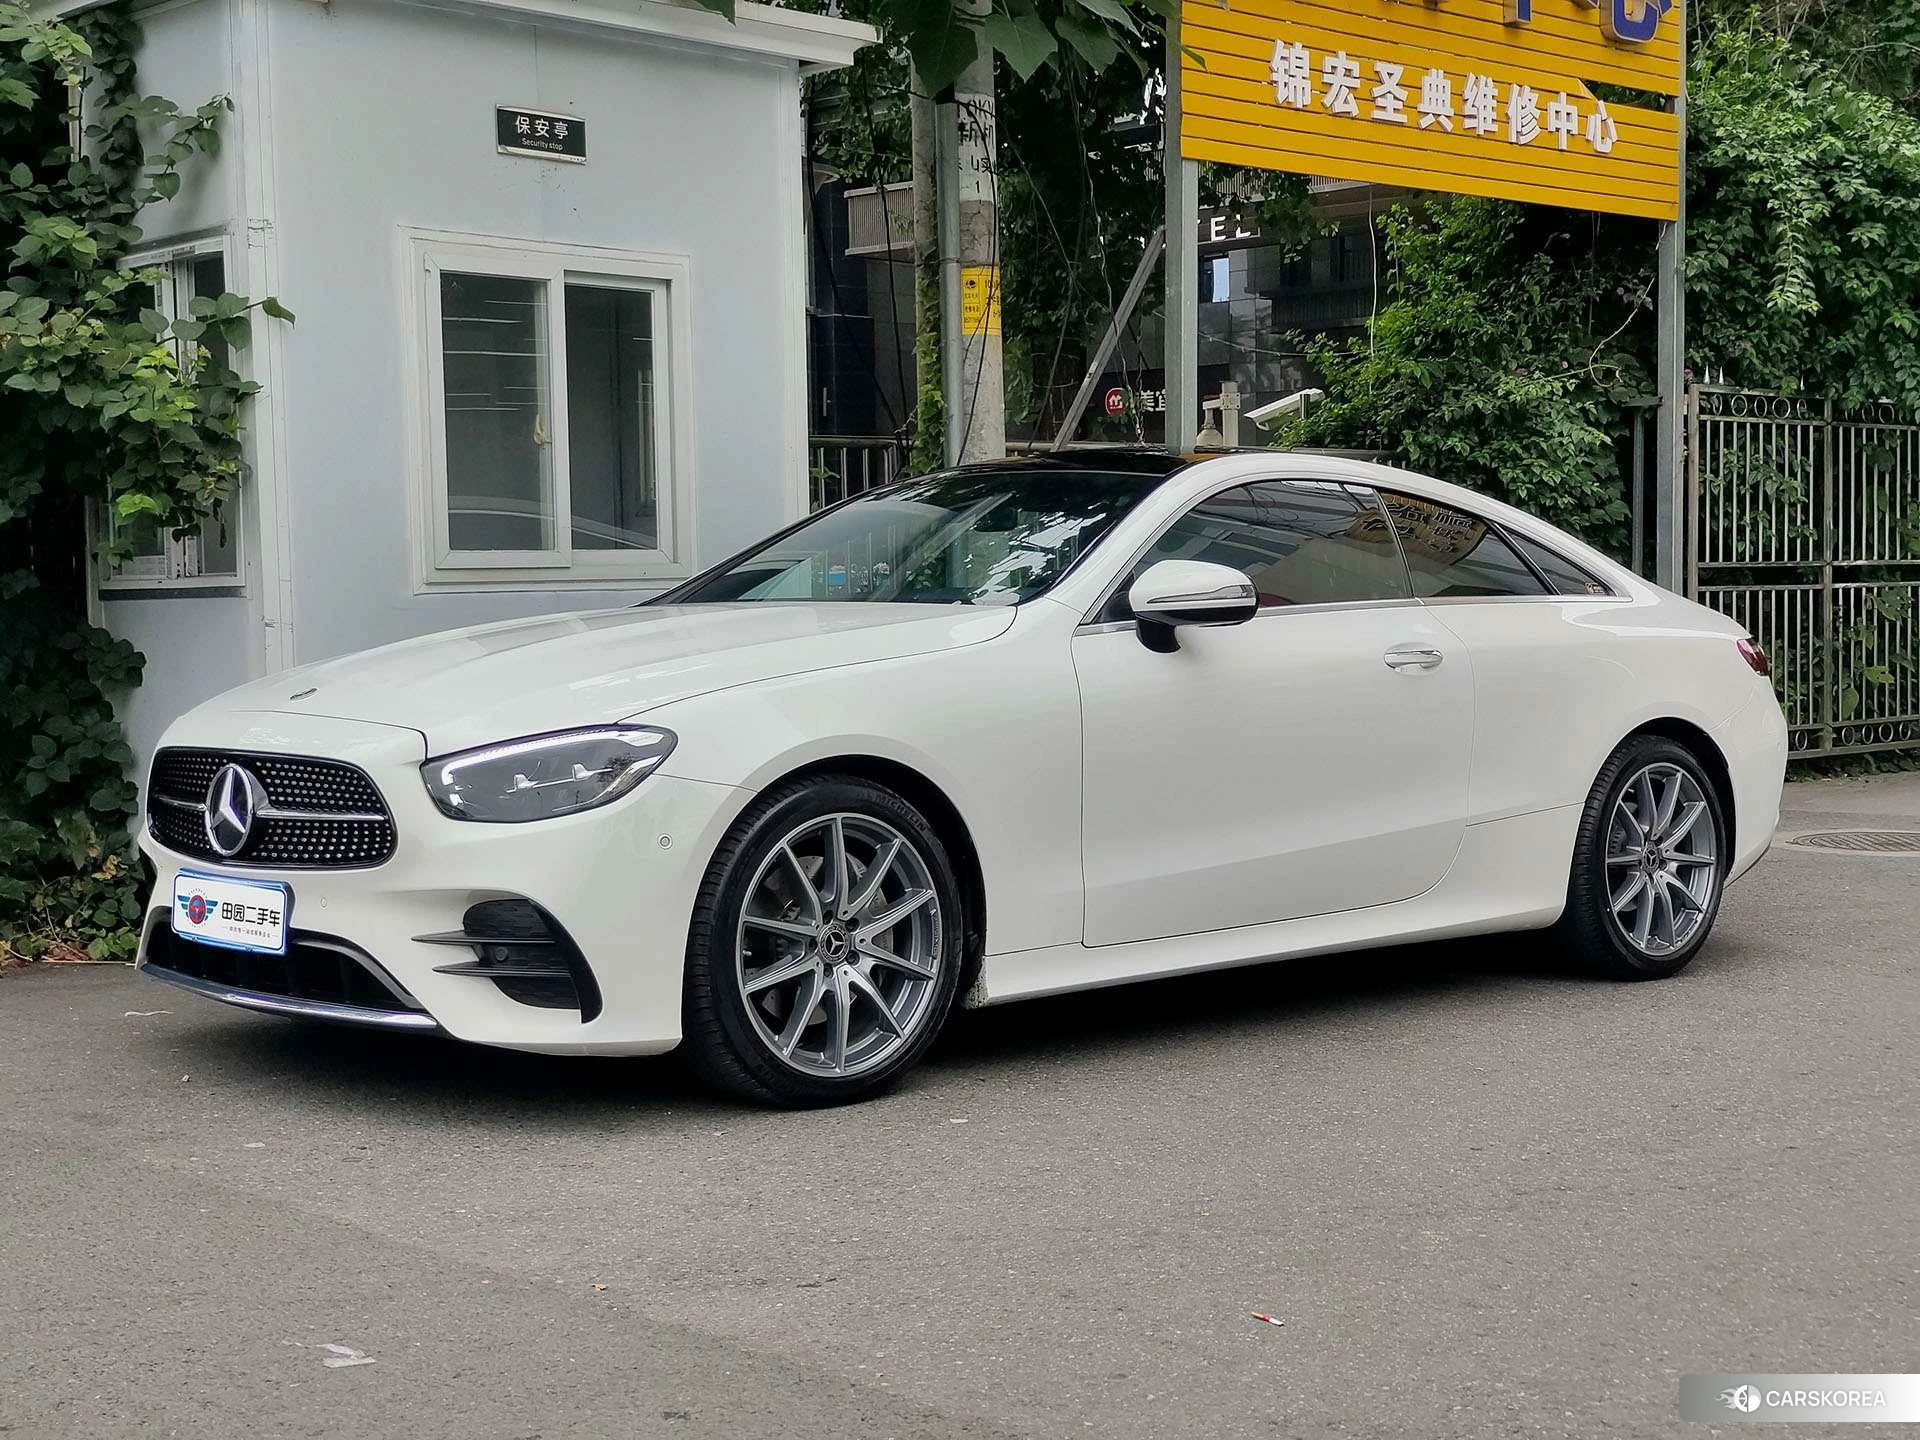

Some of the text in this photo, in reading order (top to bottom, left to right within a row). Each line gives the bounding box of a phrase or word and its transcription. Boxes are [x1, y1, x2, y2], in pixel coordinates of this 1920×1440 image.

[1270, 38, 1618, 153] 锦宏圣典维修中心
[515, 115, 568, 140] 保安亭
[521, 138, 563, 151] Security stop
[1197, 213, 1251, 242] EL
[221, 902, 280, 927] 田园二手车
